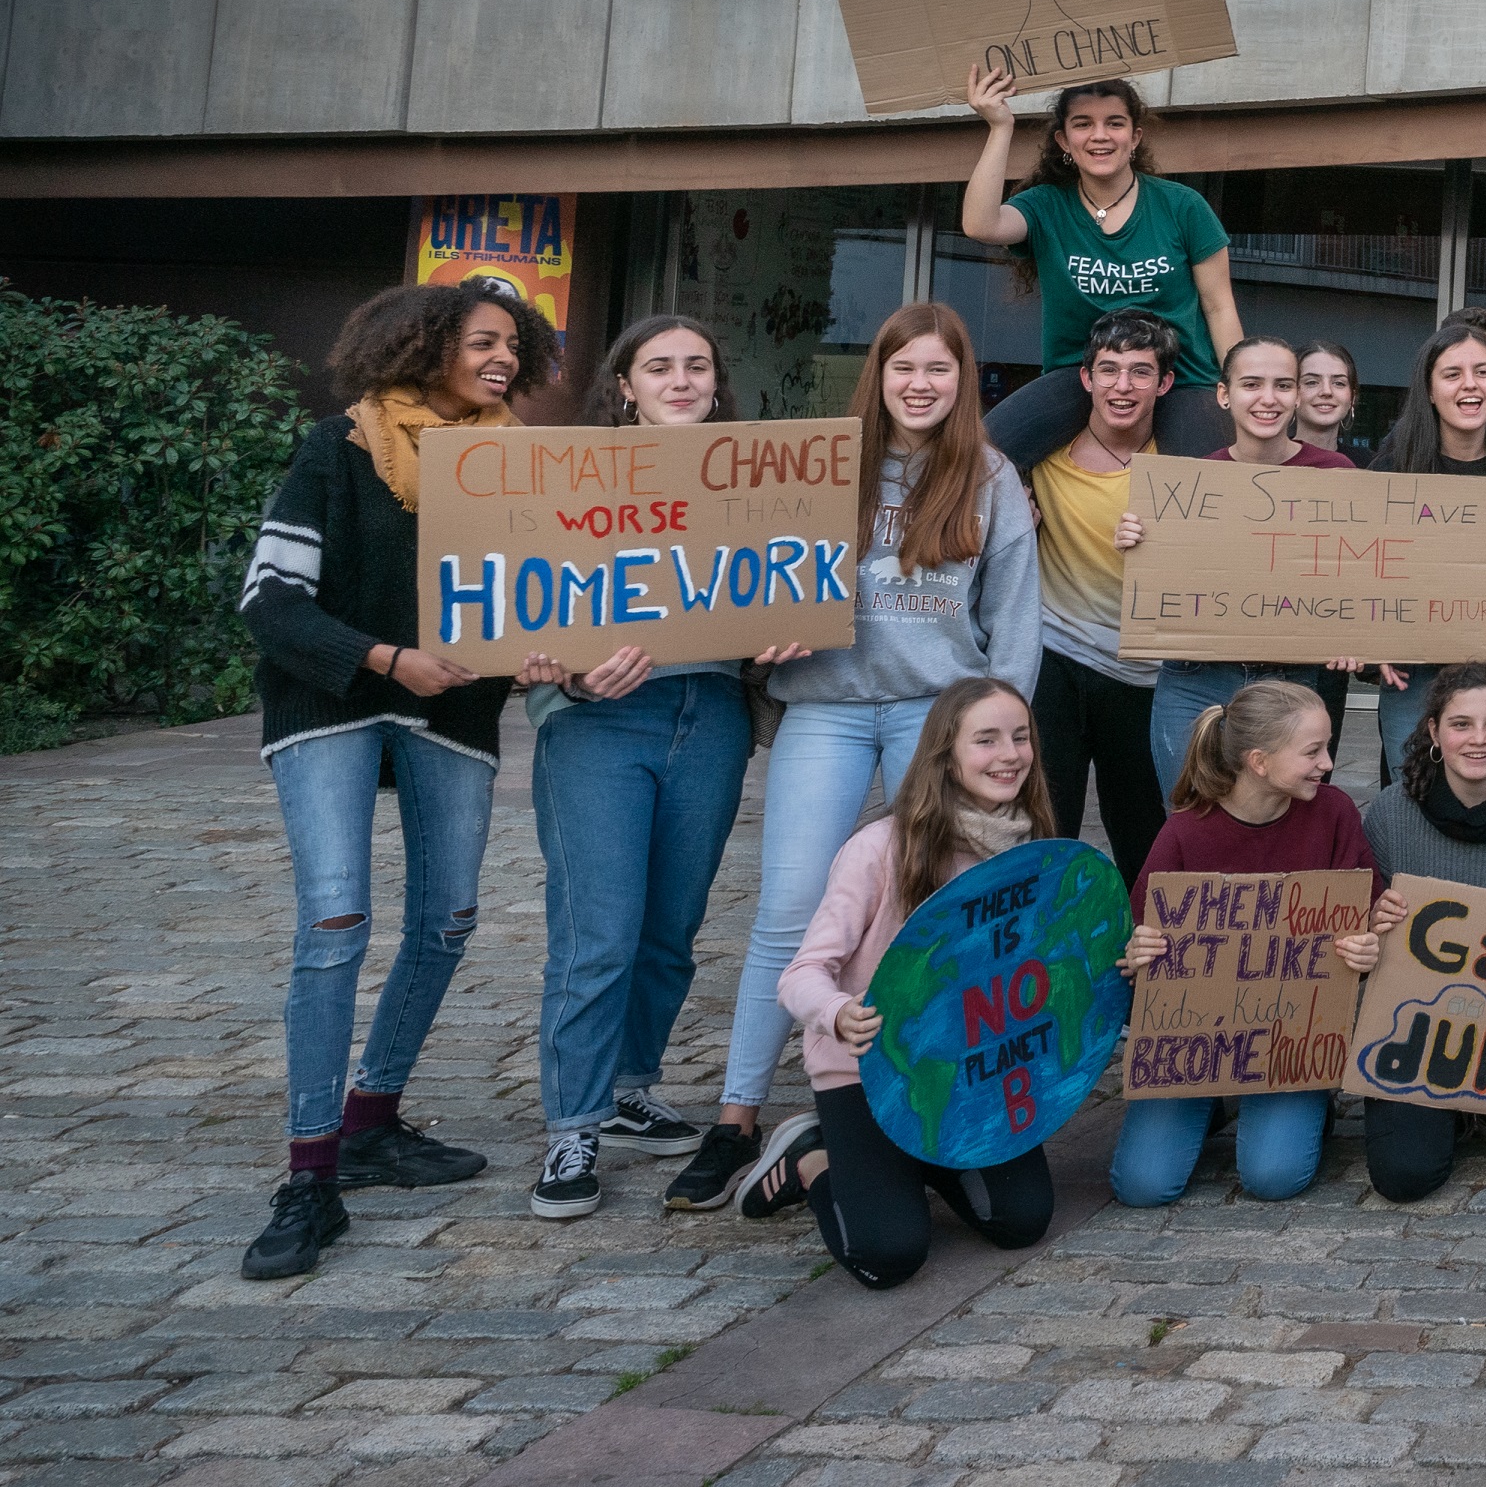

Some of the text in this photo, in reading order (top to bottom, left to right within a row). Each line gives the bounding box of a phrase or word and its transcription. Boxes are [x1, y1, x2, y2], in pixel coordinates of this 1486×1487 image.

[985, 18, 1167, 80] ONE CHANCE
[430, 194, 562, 256] GRETA
[434, 250, 562, 266] ELS TRIHUMANS
[1068, 255, 1175, 278] FEARLESS.
[455, 434, 852, 498] CLIMATE CHANGE
[510, 496, 813, 539] IS WORSE THAN
[1146, 470, 1478, 525] WE STILL HAVE
[926, 572, 959, 587] CLASS
[1251, 532, 1415, 580] TIME
[438, 535, 850, 645] HOMEWORK
[872, 591, 963, 619] ACADEMY
[1130, 579, 1230, 621] LET'S
[1241, 593, 1354, 621] CHANGE
[1360, 598, 1419, 623] THE
[960, 875, 1041, 930] THERE
[1151, 880, 1370, 937] WHEN leaders
[1146, 933, 1335, 982] ACT LIKE
[962, 958, 1051, 1049] NO
[963, 1021, 1054, 1087] PLANET
[1128, 1028, 1271, 1090] BECOME
[1002, 1066, 1037, 1135] B
